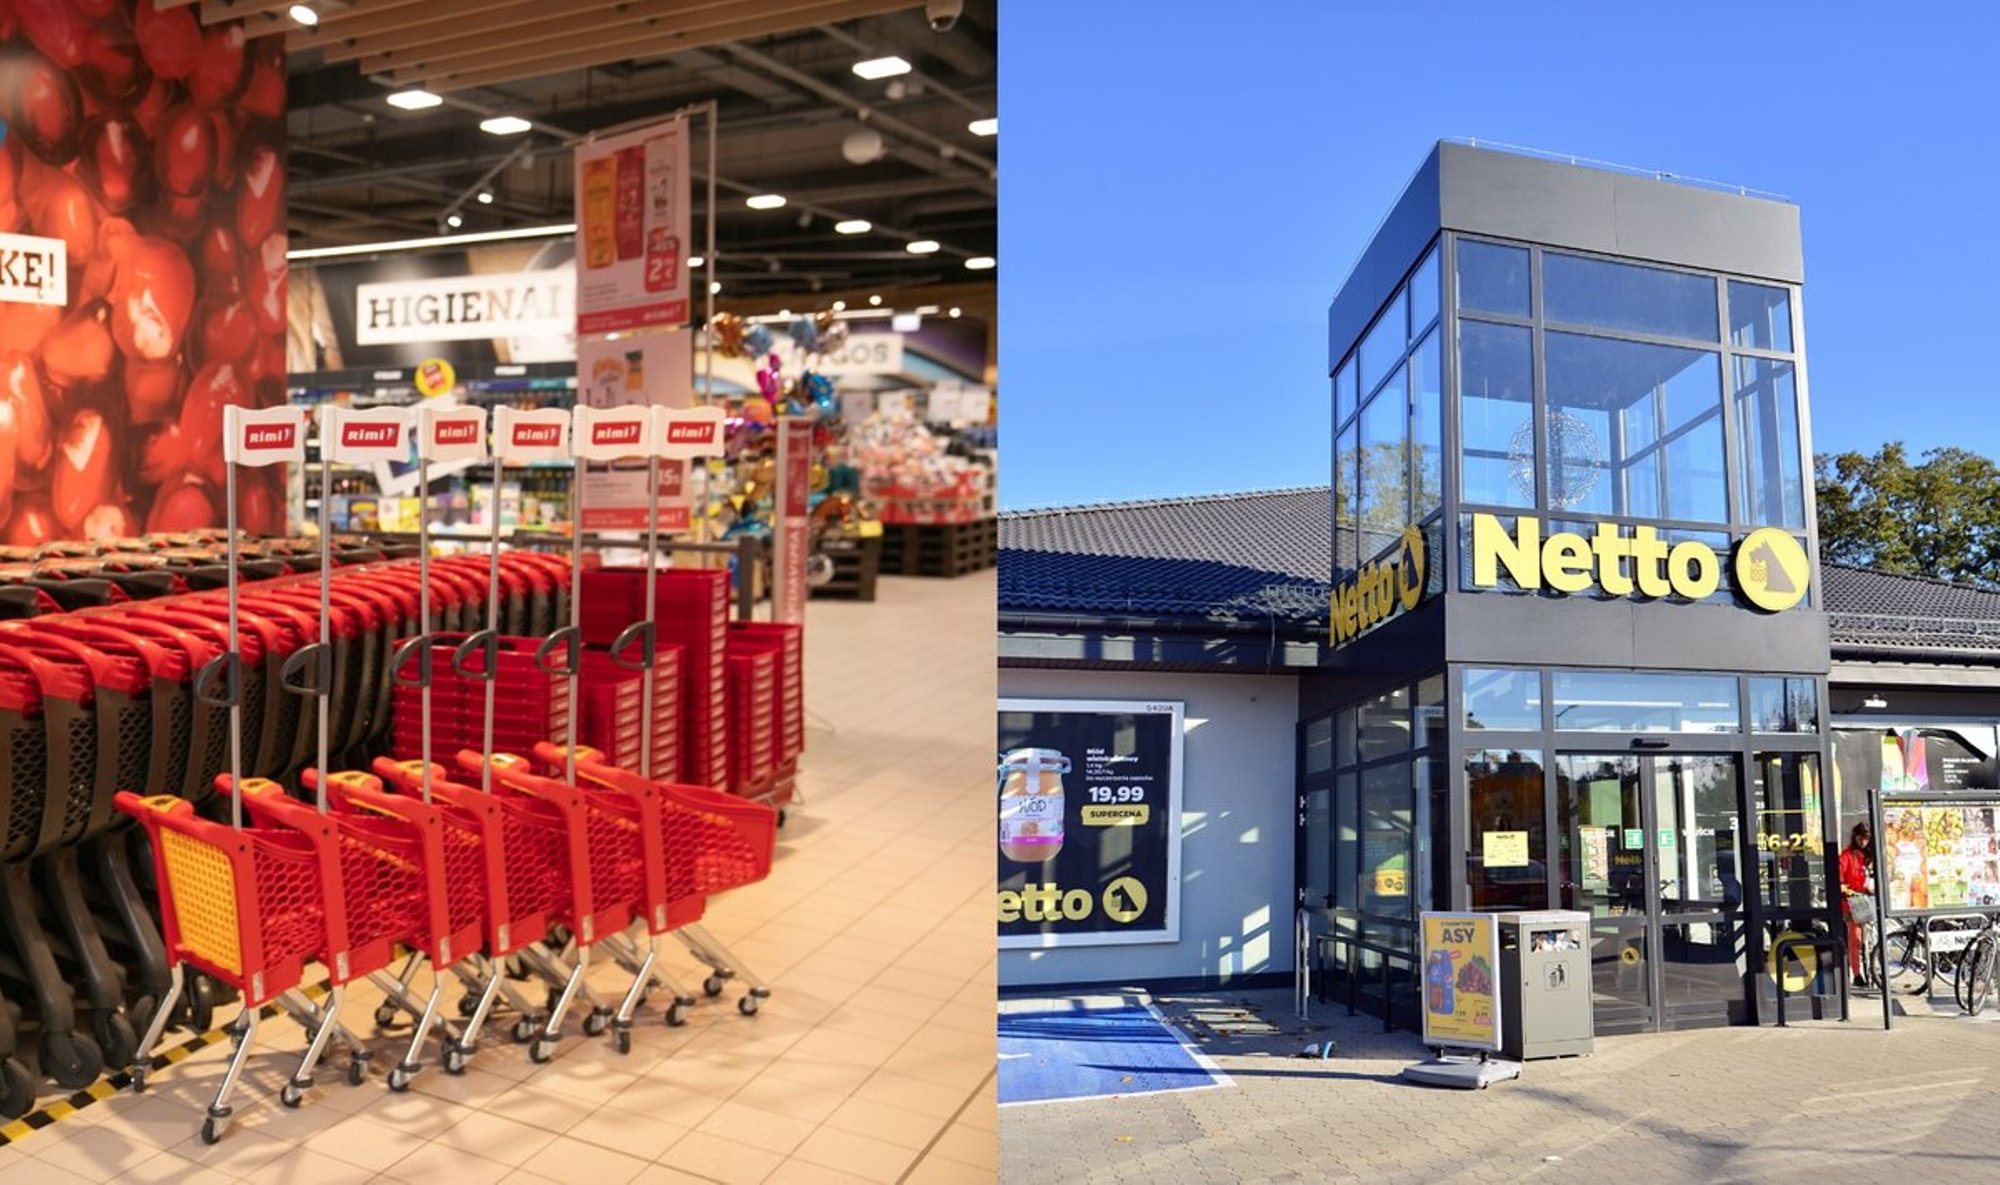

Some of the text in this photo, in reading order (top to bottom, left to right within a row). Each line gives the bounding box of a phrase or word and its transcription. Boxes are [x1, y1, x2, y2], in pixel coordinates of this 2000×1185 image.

[1473, 513, 1720, 599] Netto
[1328, 559, 1393, 648] Netto
[1088, 786, 1144, 804] 19,99
[1090, 810, 1142, 818] SUPERCENA
[1442, 928, 1475, 943] ASY
